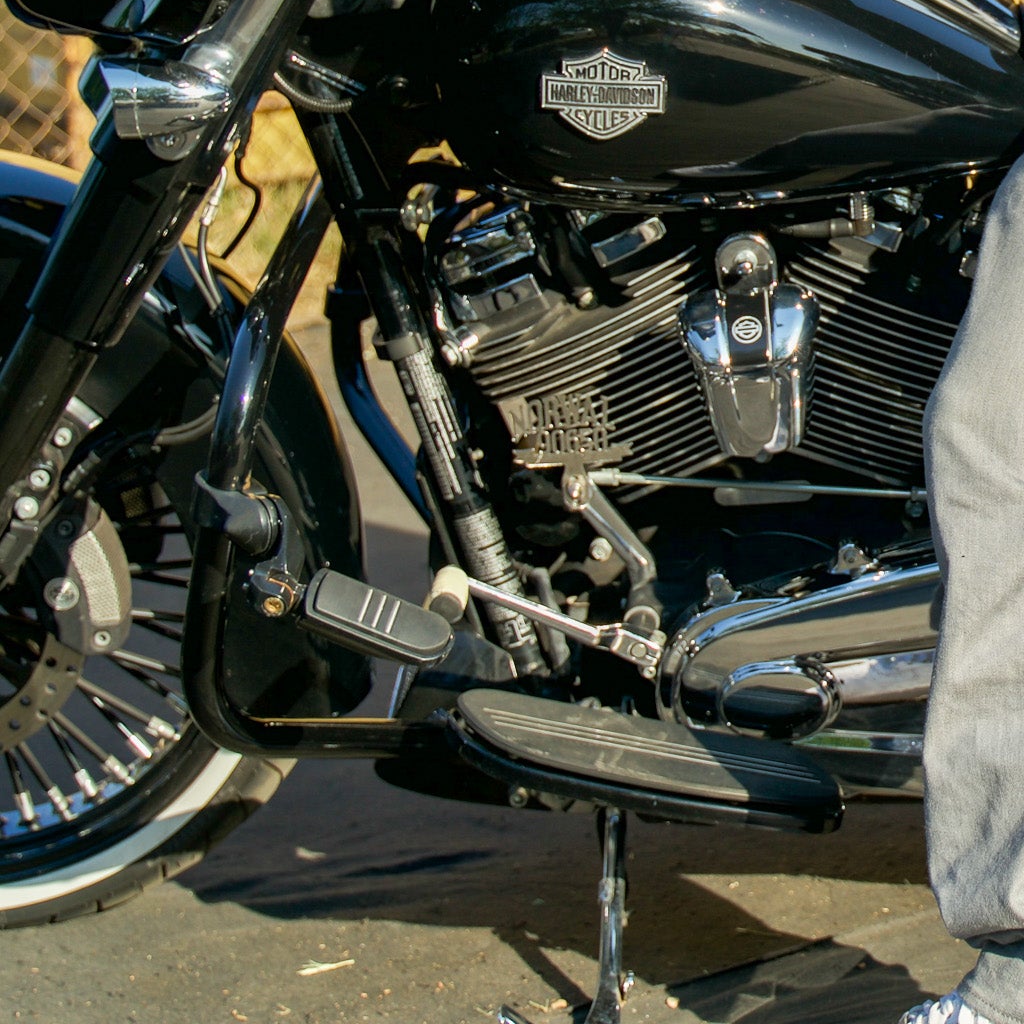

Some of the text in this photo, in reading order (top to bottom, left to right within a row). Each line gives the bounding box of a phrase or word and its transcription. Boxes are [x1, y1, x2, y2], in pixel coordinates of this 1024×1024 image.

[575, 61, 632, 82] MOTOR
[550, 83, 656, 106] HARLEY-DAVIDSON
[574, 109, 631, 132] CYCLES
